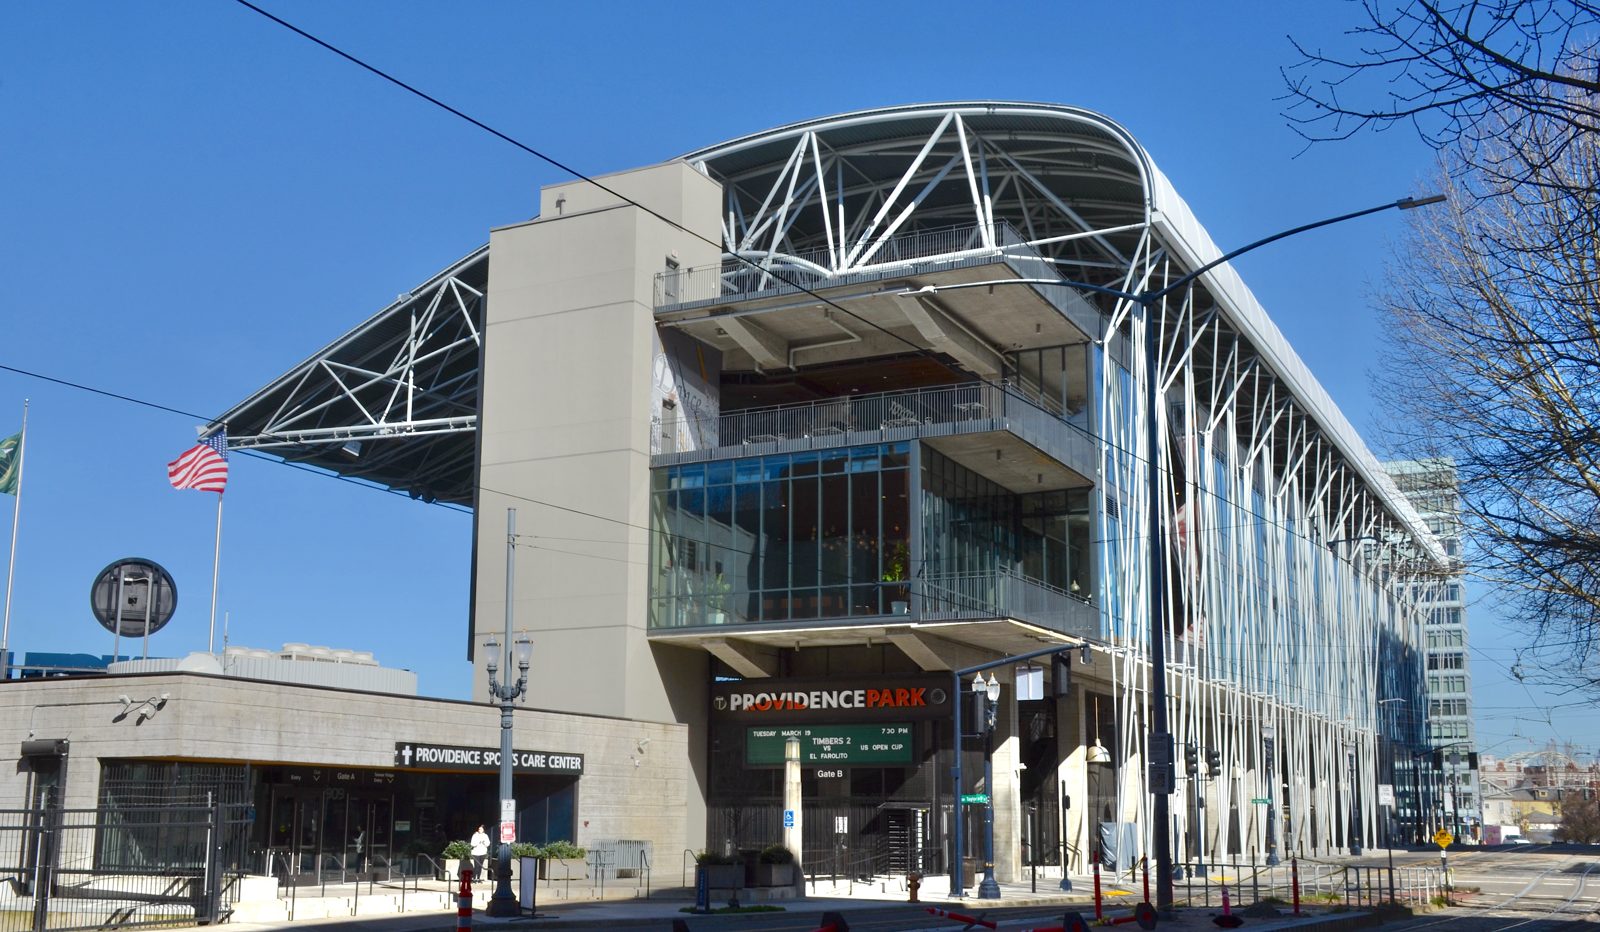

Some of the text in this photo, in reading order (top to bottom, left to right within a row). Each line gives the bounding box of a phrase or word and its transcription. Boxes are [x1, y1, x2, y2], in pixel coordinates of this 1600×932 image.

[812, 737, 844, 745] TIMBERS
[416, 747, 480, 765] PROVIDENCE
[521, 754, 546, 768] CARE
[548, 755, 581, 770] CENTER
[817, 770, 836, 778] Gate
